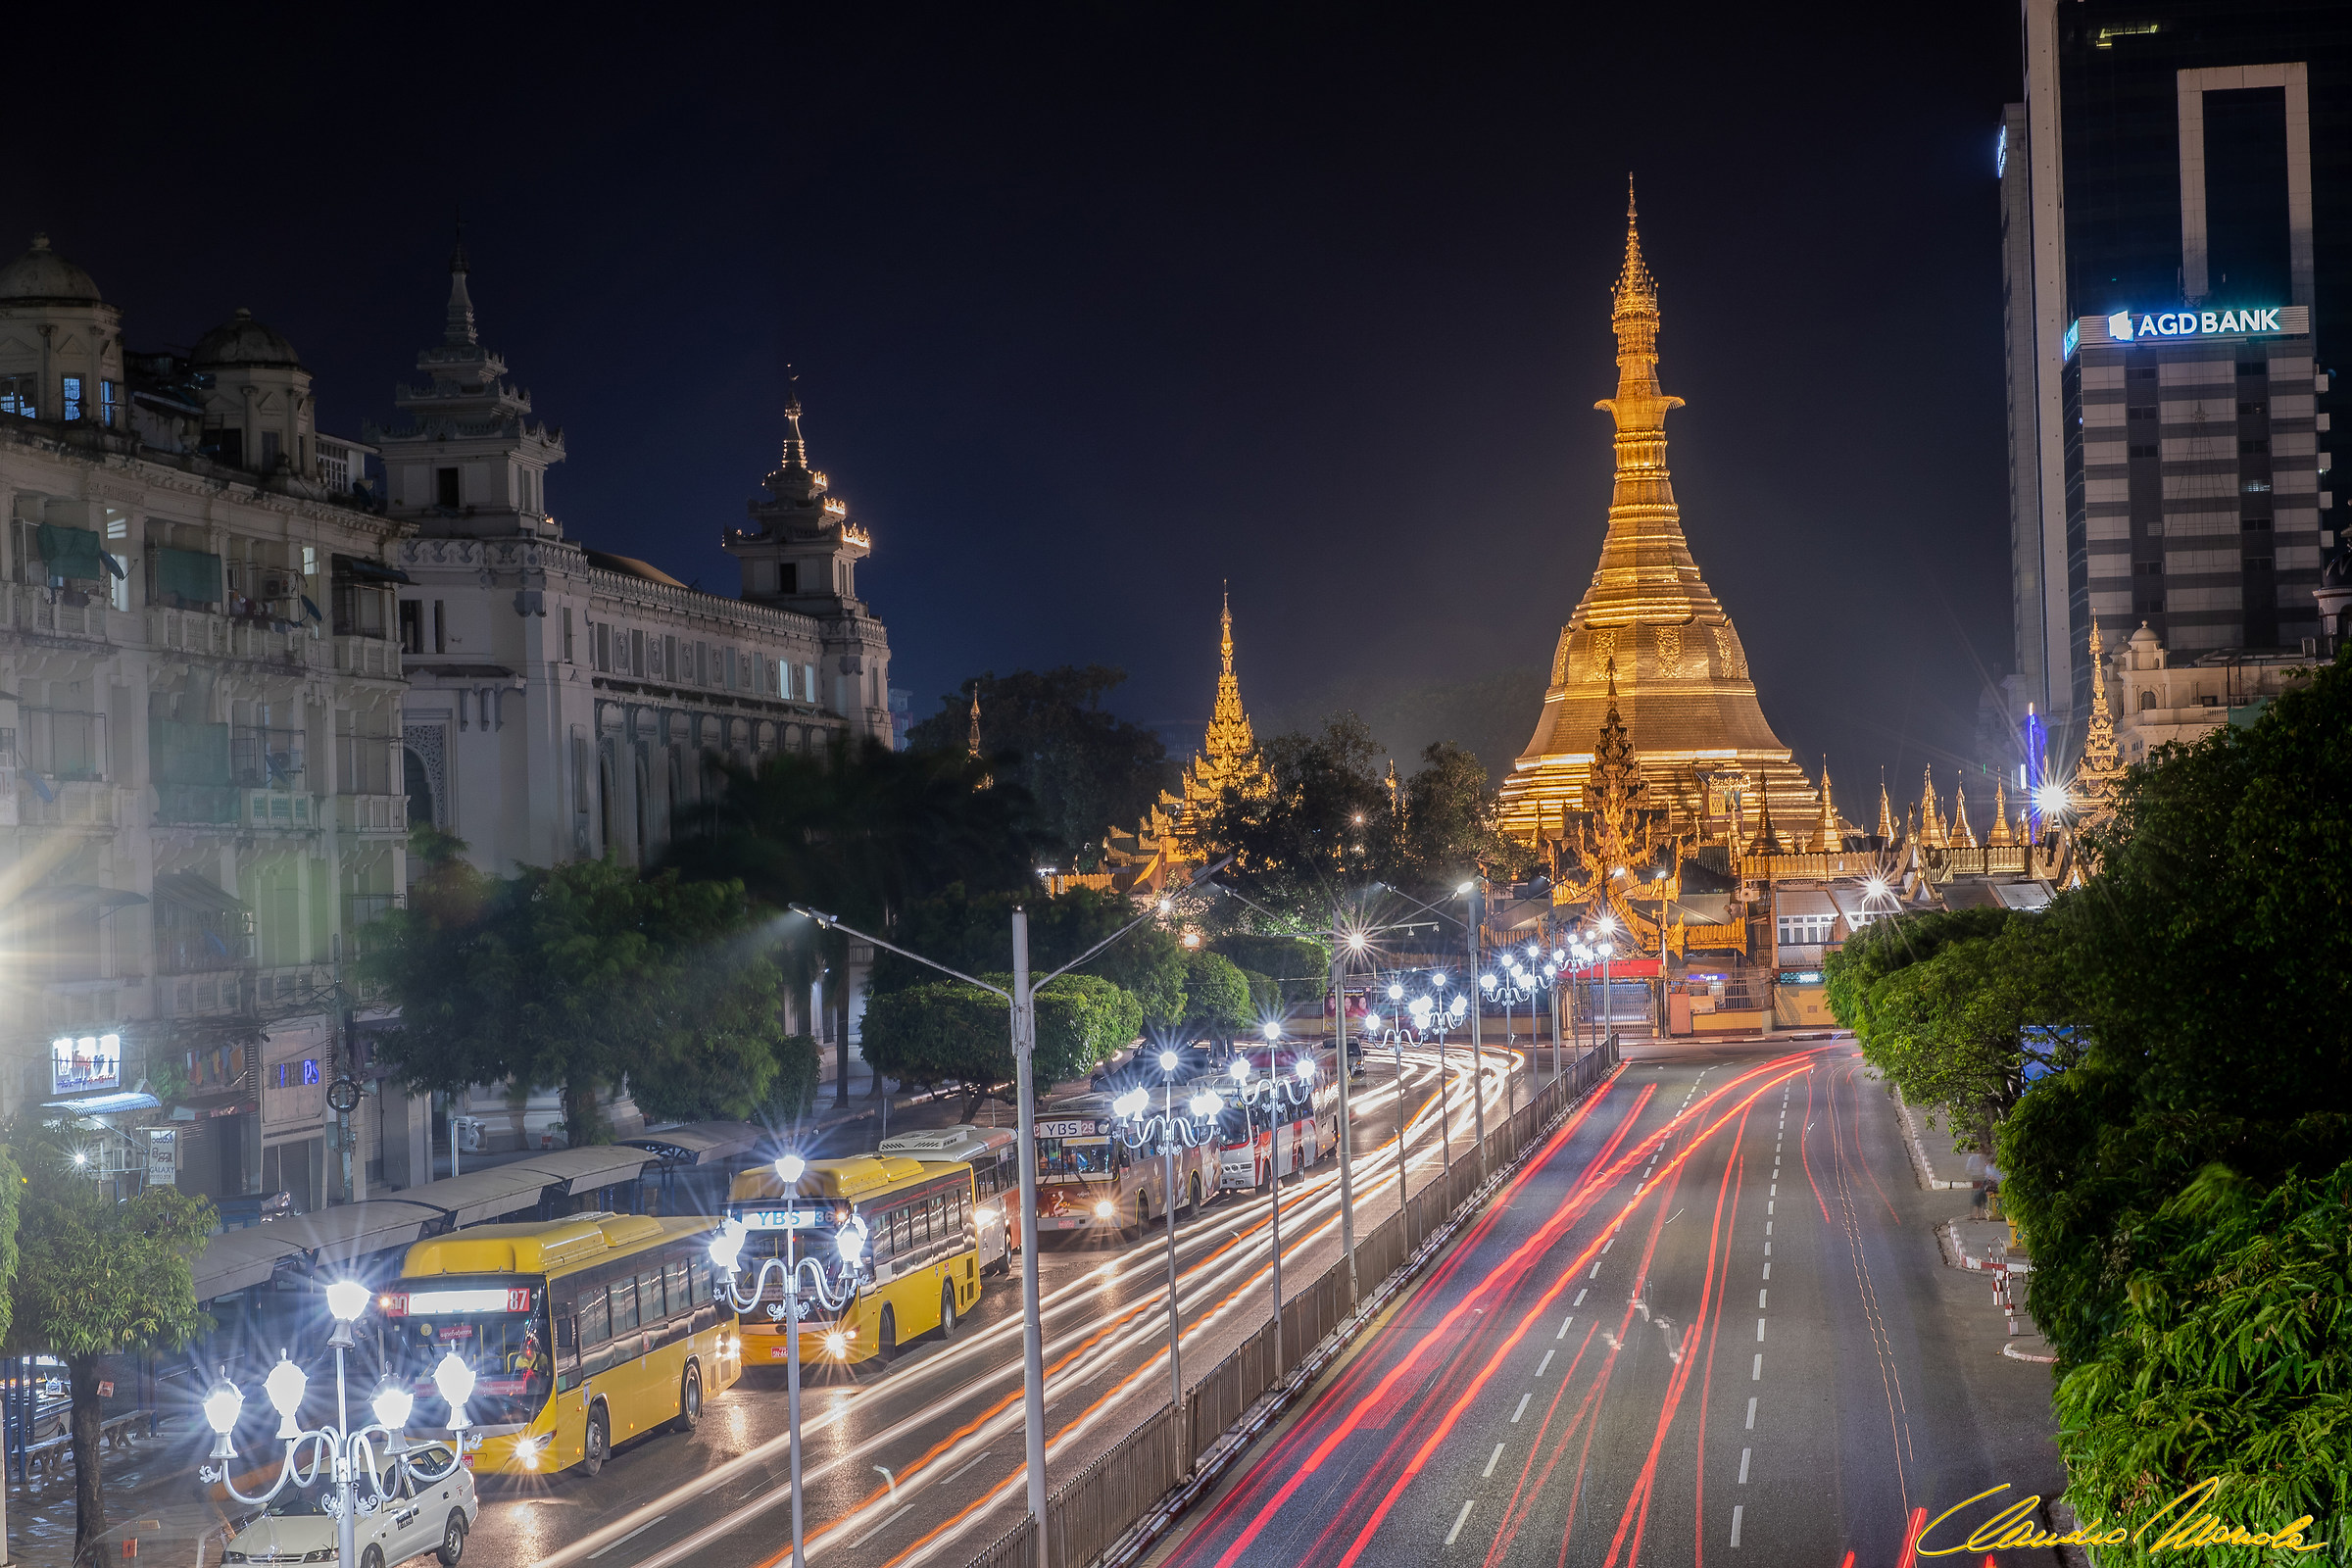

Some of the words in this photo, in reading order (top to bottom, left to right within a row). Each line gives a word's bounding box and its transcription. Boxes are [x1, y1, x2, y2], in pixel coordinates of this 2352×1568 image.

[2137, 313, 2197, 336] AGD
[2201, 309, 2280, 333] BANK
[1047, 1123, 1078, 1136] YBS
[1081, 1122, 1095, 1134] 29
[757, 1211, 801, 1226] YBS
[815, 1211, 835, 1223] 36
[510, 1290, 527, 1310] 87
